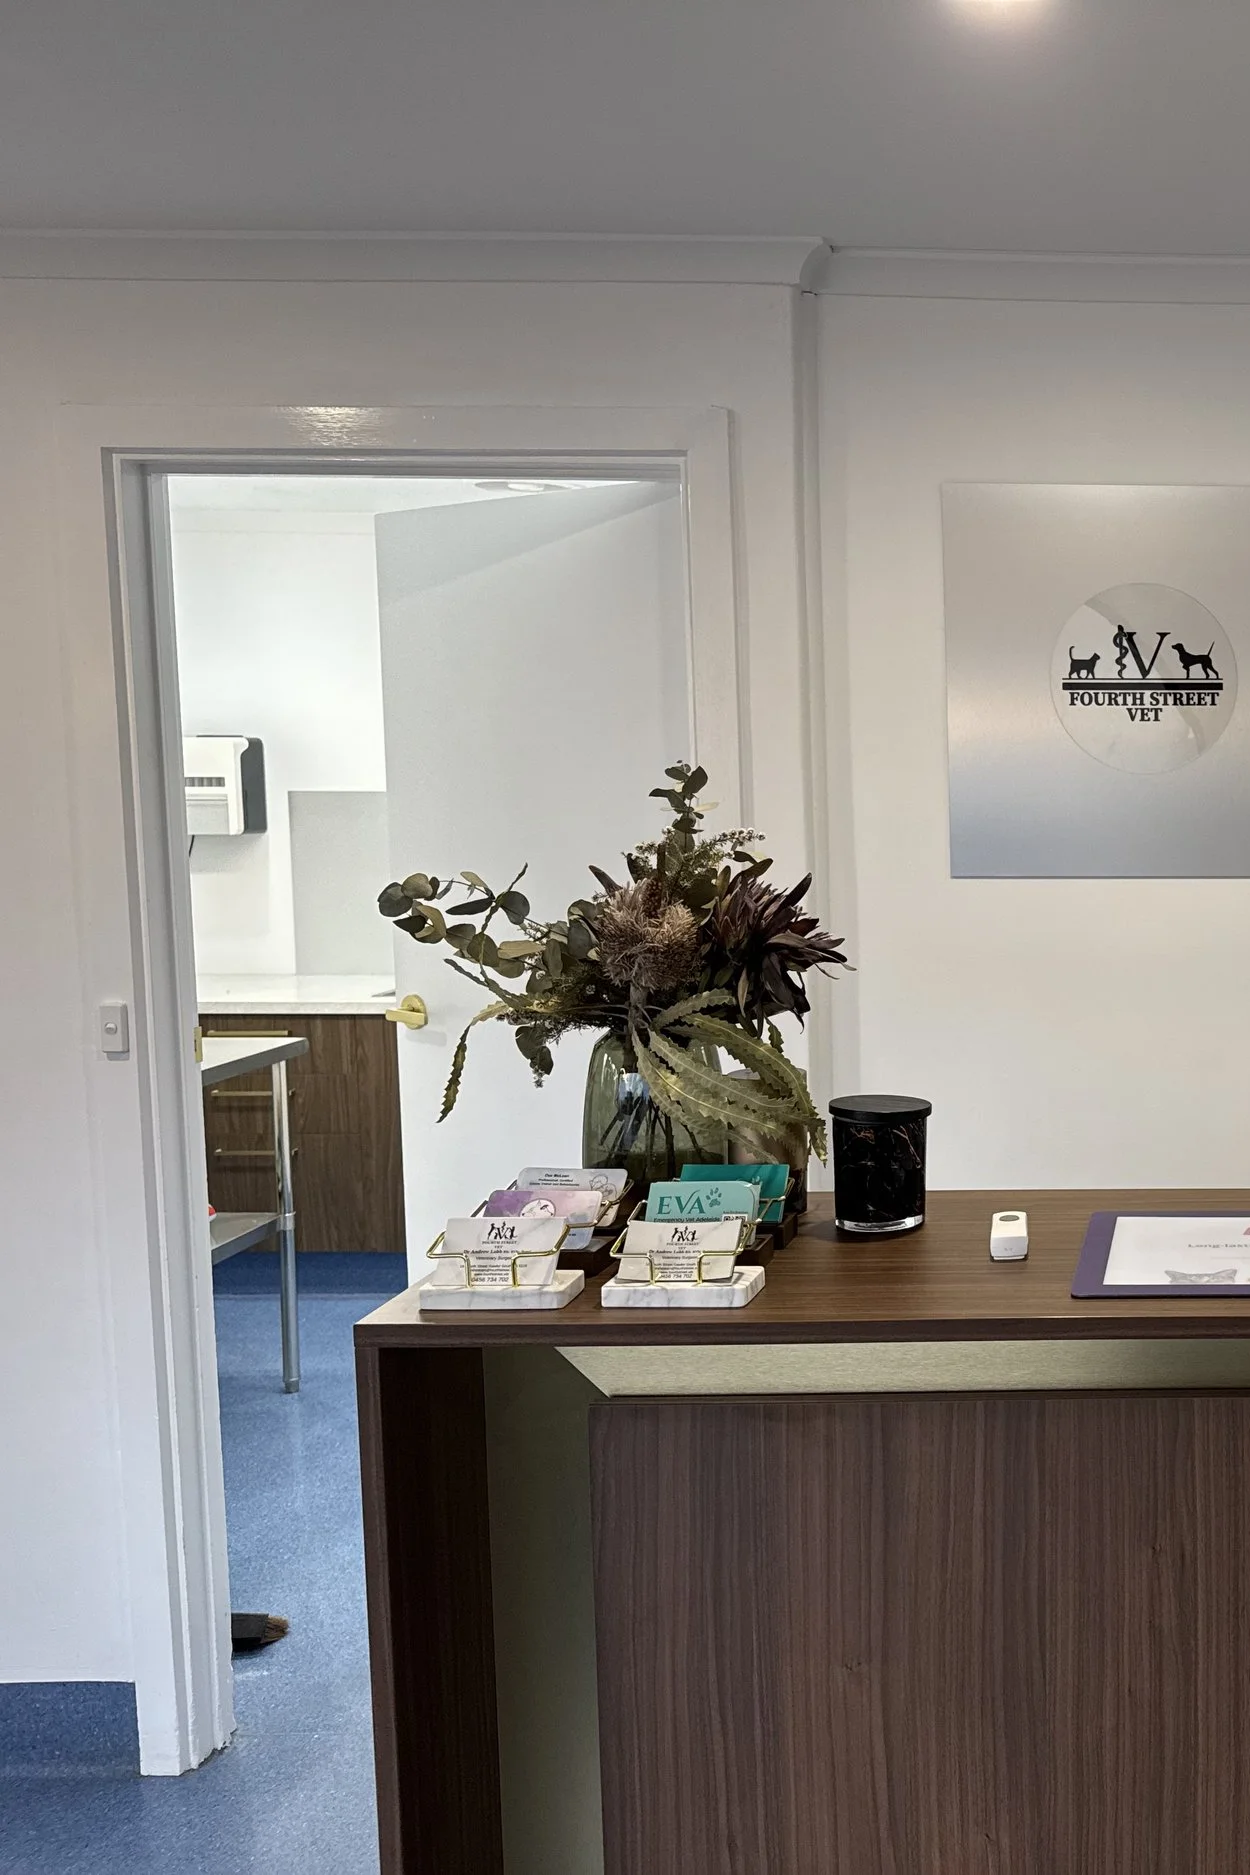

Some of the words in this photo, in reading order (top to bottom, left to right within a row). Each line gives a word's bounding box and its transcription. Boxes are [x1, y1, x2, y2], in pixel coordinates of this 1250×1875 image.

[1068, 691, 1146, 707] FOURTH
[1149, 691, 1220, 707] STREET
[1125, 707, 1163, 723] VET
[656, 1189, 706, 1215] EVA
